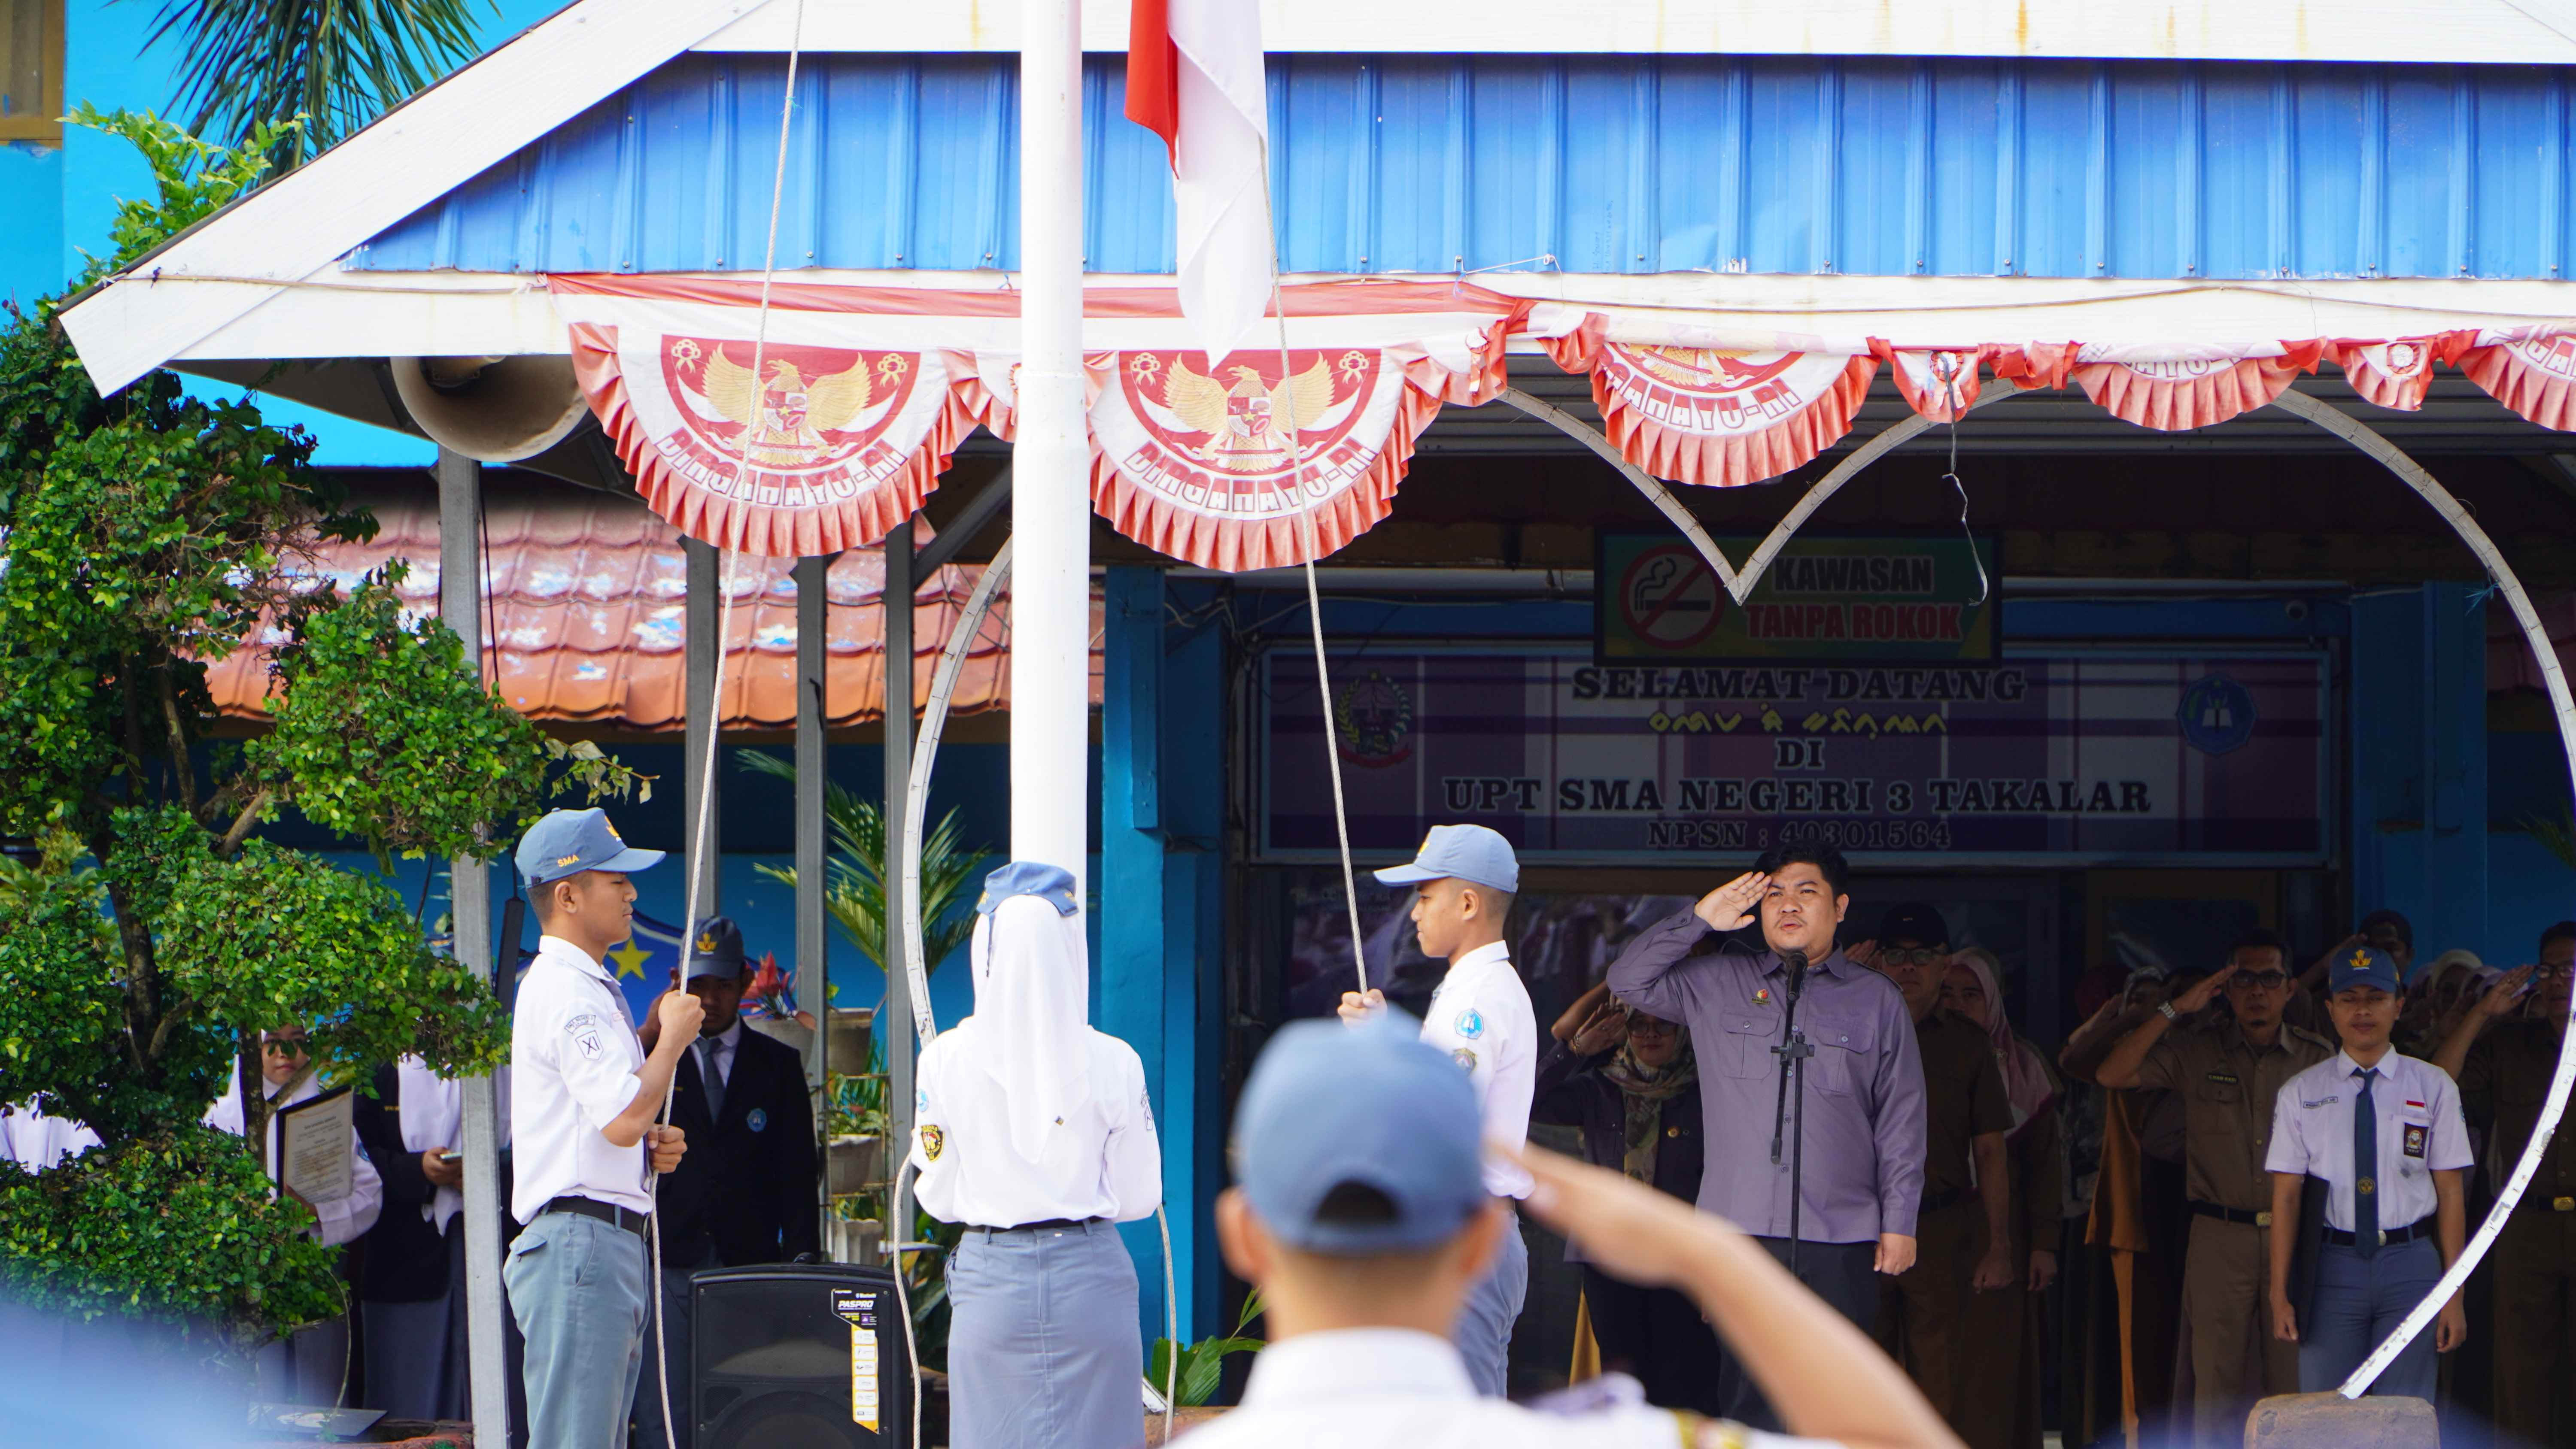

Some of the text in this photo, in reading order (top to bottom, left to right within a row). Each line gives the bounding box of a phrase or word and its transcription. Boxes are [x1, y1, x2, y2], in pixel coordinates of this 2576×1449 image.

[653, 427, 908, 507] DIRGAHAYU-RI
[1122, 436, 1379, 512] DIRGAHAYU-RI
[1774, 557, 1933, 593] KAWASAN
[1745, 604, 1963, 640] TANPA ROKOK
[1571, 667, 2027, 702] SELAMAT DATANG
[1774, 739, 1826, 770] DI
[1443, 778, 2151, 814] UPT SMA NEGERI 3 TAKALAR
[1648, 821, 1748, 847] NPSN
[1779, 820, 1951, 848] 40301564
[557, 855, 580, 867] SMA
[582, 1036, 600, 1055] XI
[838, 1300, 874, 1308] PASPRO
